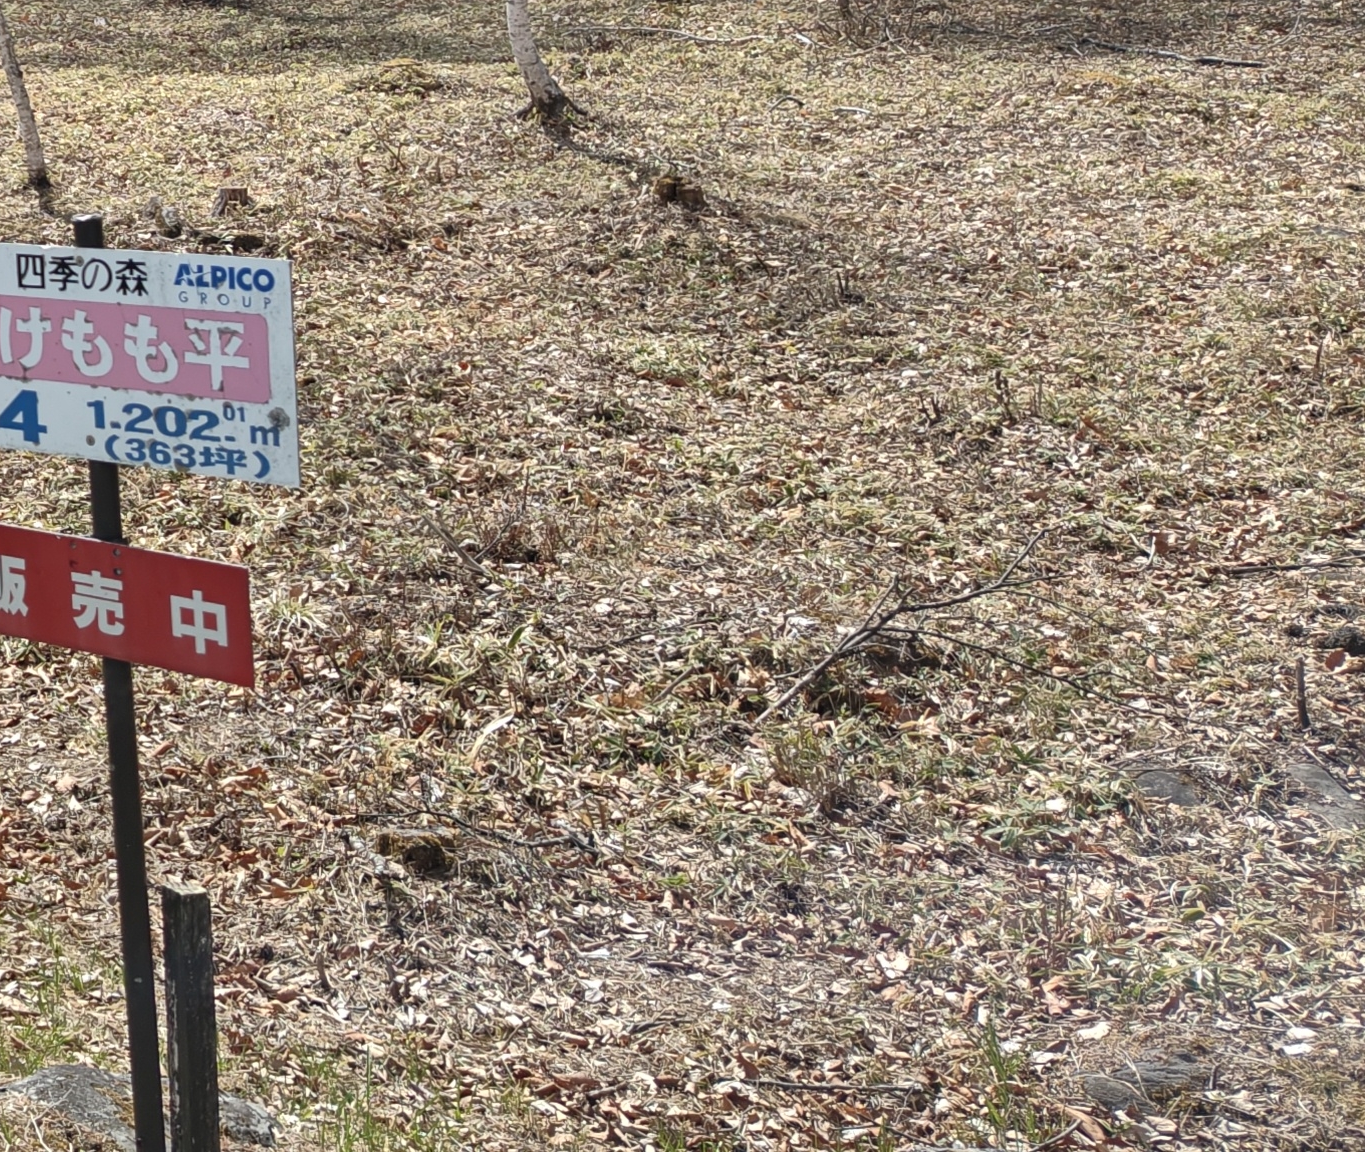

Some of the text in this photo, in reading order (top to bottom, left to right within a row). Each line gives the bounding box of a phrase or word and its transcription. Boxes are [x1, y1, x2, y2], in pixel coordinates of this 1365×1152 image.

[15, 253, 150, 297] 四季の森
[173, 263, 276, 293] ALPICO
[177, 290, 272, 309] GROUP
[104, 434, 271, 480] (363坪)
